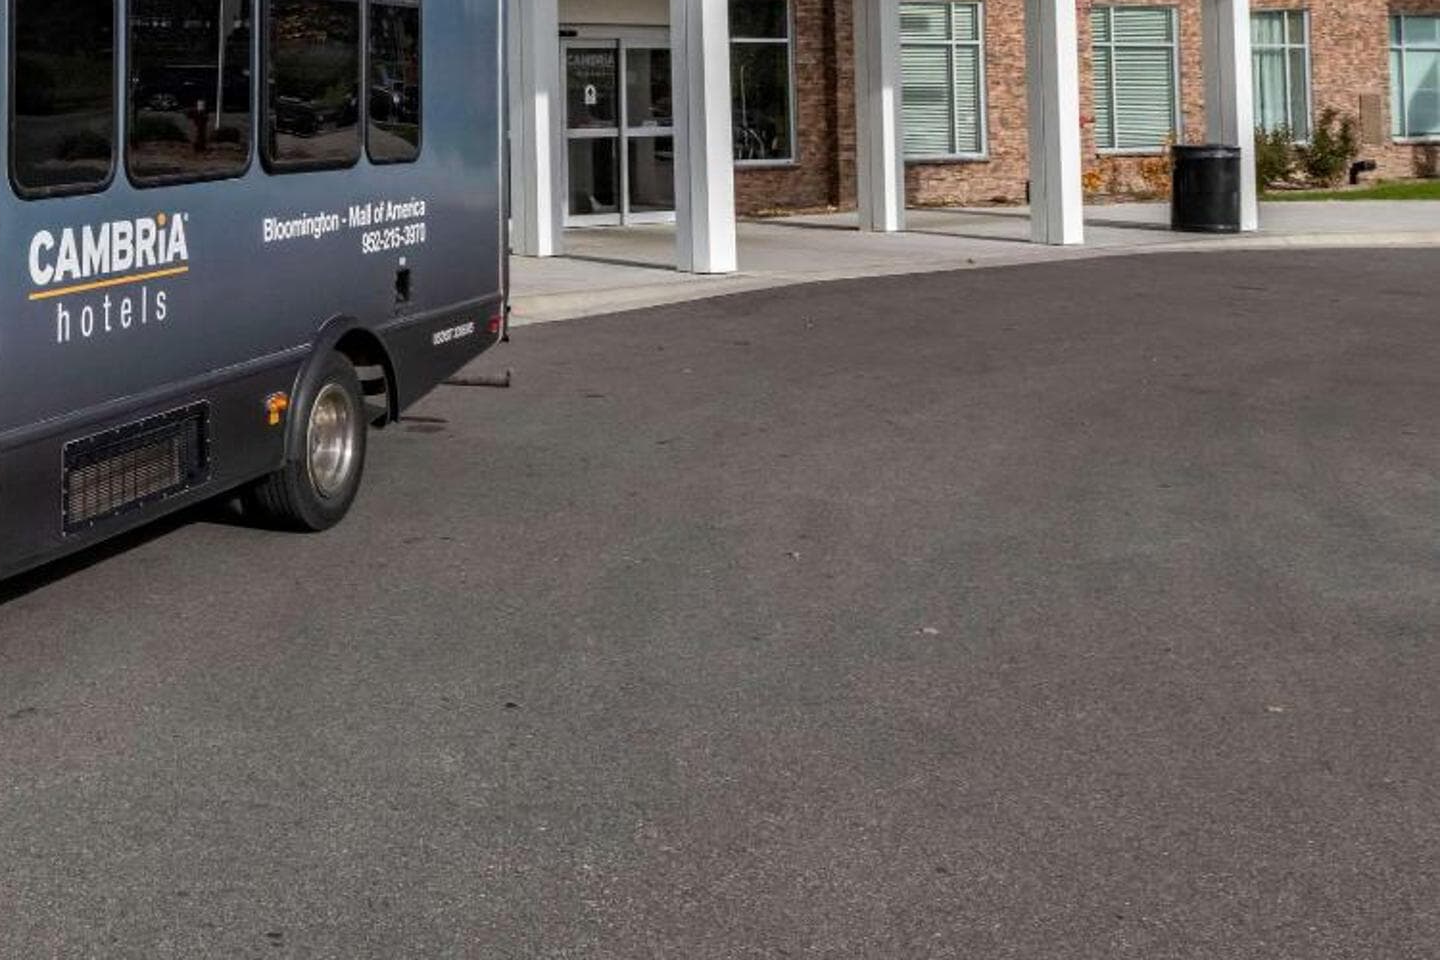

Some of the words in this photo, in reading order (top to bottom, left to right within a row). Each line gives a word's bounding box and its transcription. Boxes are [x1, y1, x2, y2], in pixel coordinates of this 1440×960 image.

[263, 213, 339, 243] Bloomington
[348, 203, 371, 228] Mall
[373, 200, 385, 224] of
[385, 197, 426, 221] America
[56, 286, 166, 343] hotels
